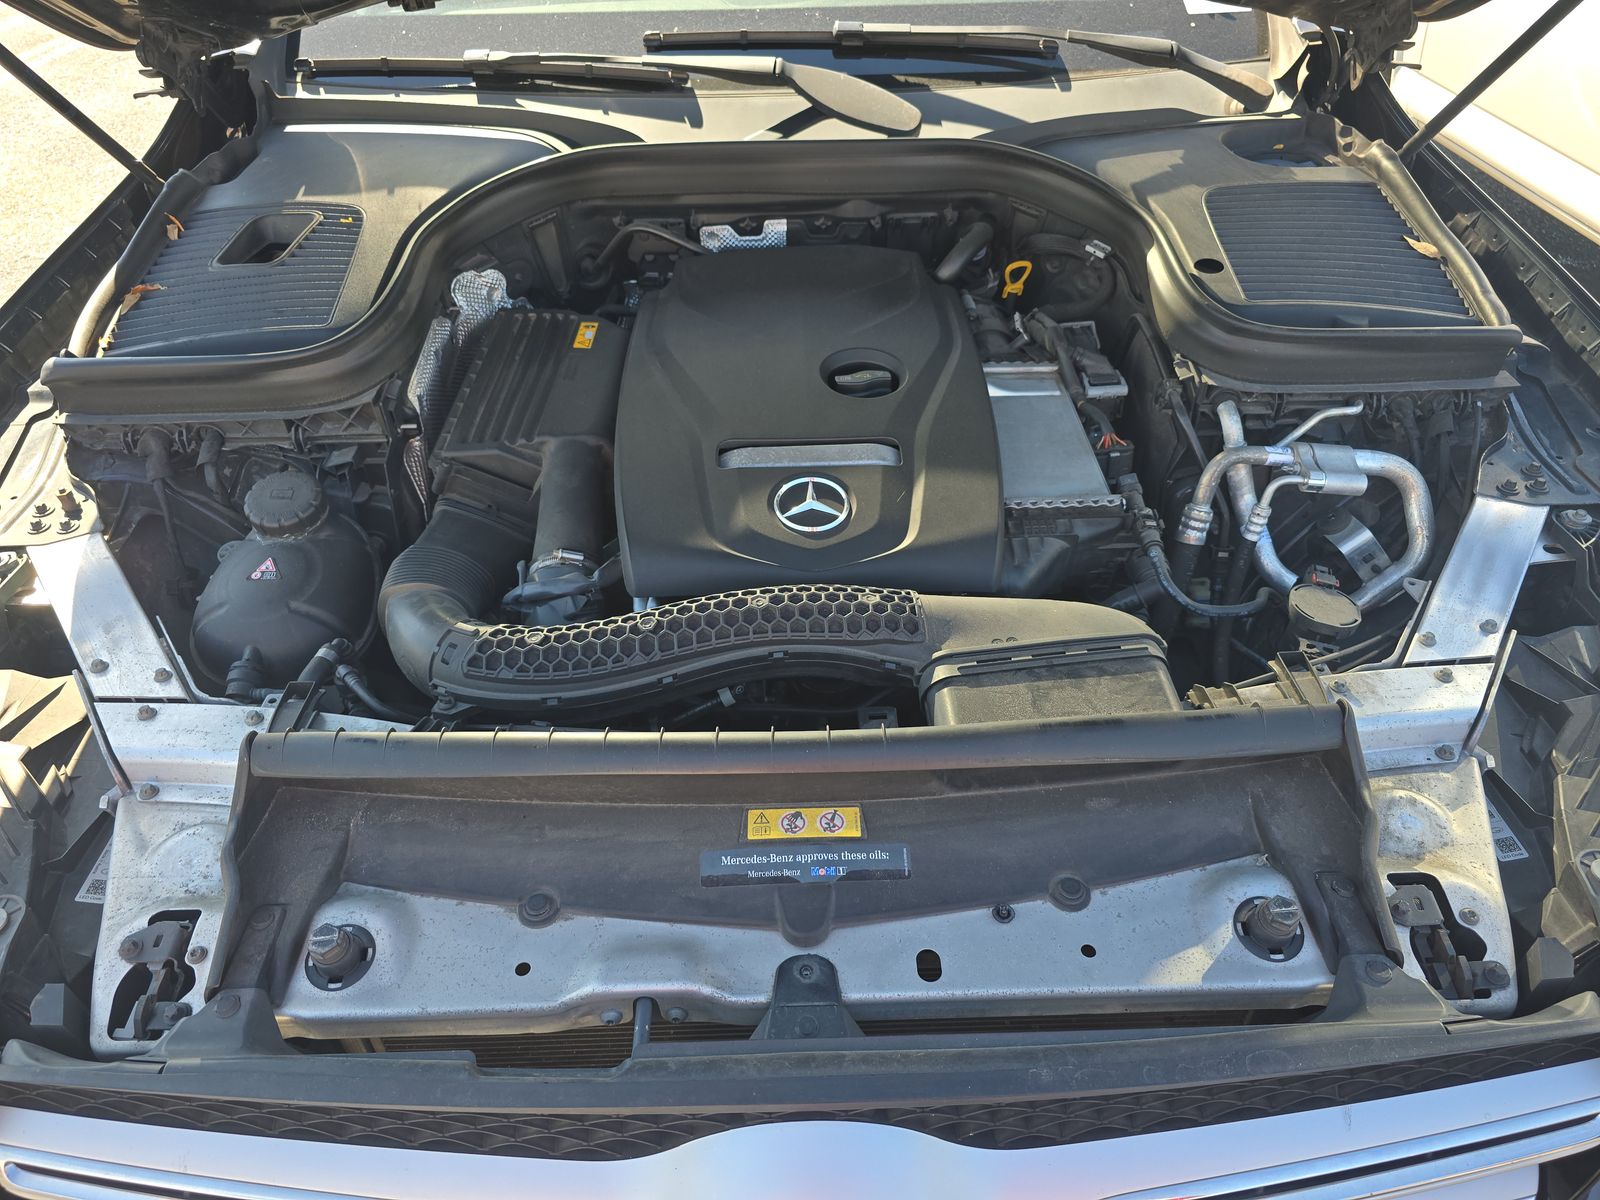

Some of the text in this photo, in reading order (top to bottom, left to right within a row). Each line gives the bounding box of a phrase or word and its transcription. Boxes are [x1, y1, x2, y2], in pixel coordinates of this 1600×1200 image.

[721, 850, 890, 866] Mercedes-Benz approves these oils:
[747, 868, 800, 878] Mercedes-Benz
[811, 866, 836, 876] Mobil
